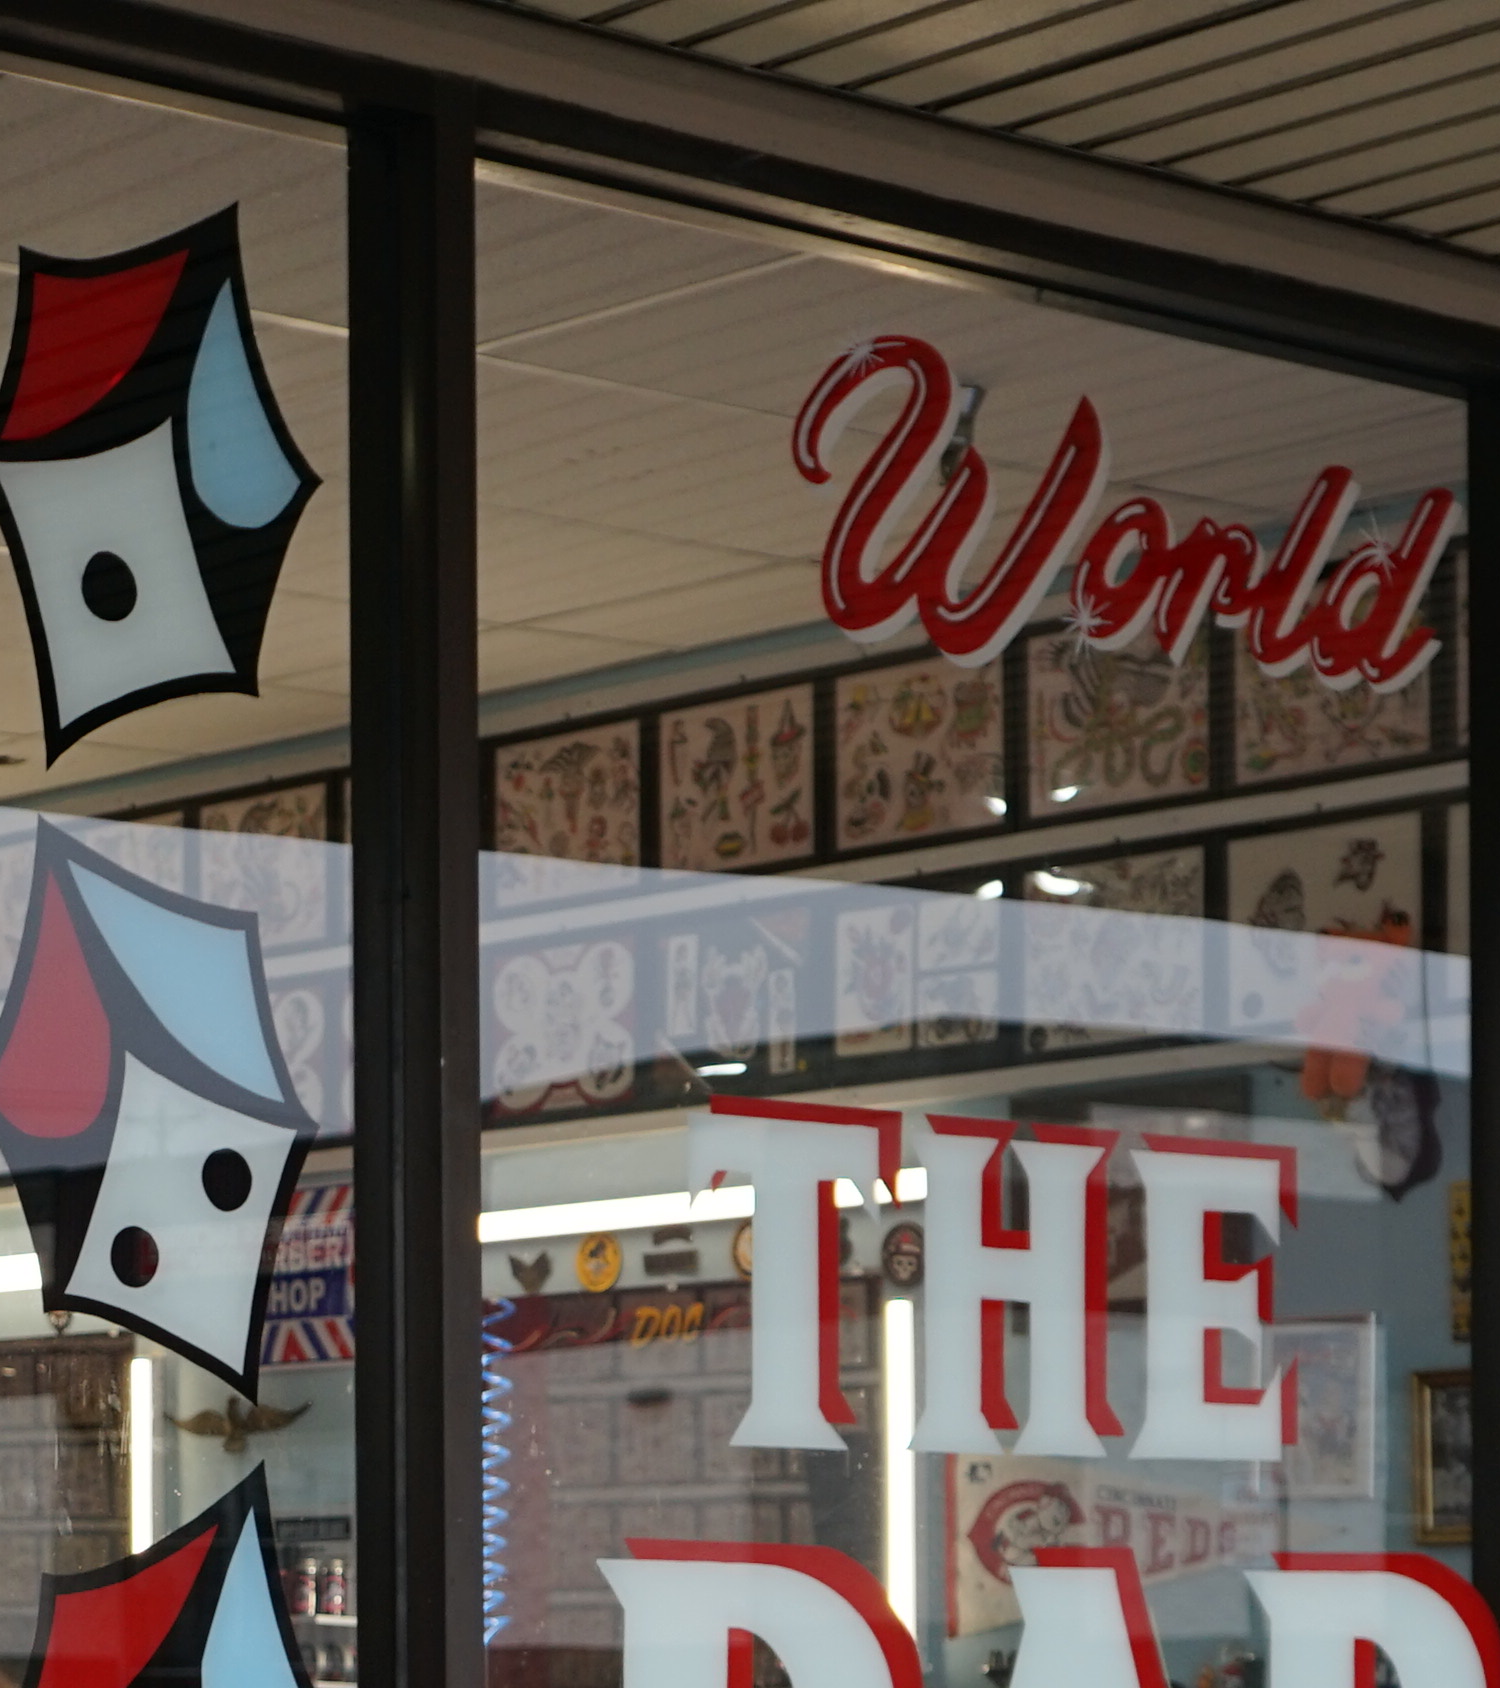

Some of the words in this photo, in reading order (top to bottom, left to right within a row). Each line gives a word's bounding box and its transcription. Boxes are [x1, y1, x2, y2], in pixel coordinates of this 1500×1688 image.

[792, 333, 1465, 695] World
[270, 1276, 327, 1315] HOP
[687, 1093, 1298, 1462] THE
[1094, 1502, 1238, 1574] REDS
